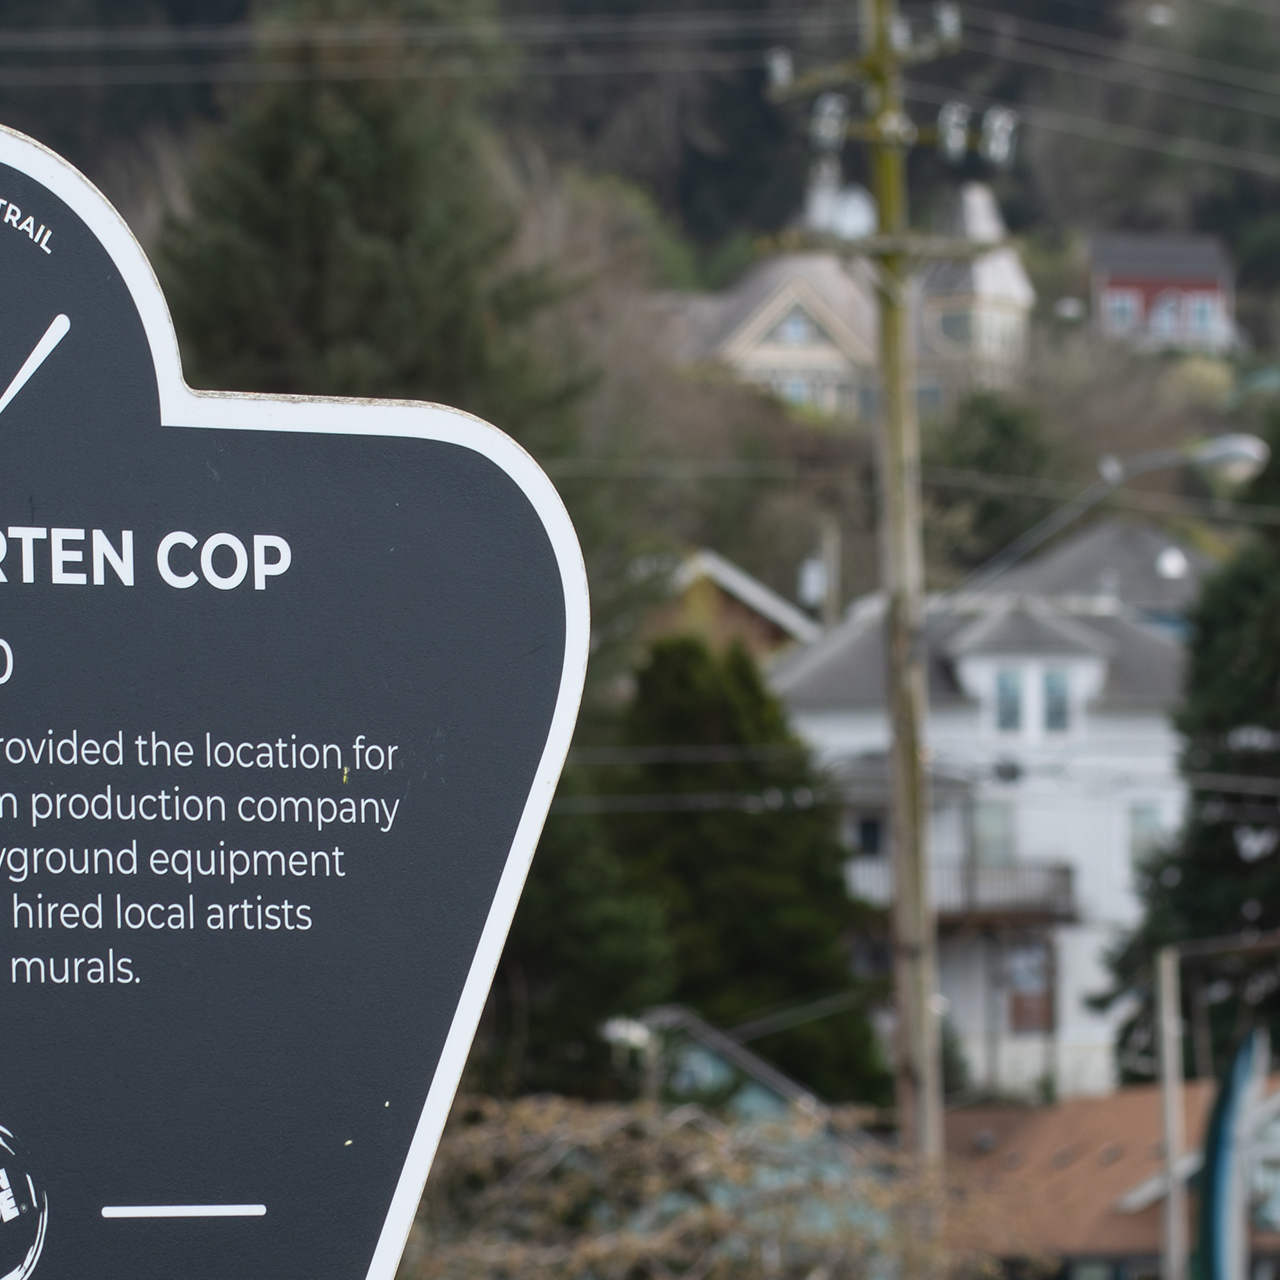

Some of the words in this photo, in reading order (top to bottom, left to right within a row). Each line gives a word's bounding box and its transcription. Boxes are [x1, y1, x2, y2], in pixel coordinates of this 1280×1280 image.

[157, 531, 291, 590] COP
[135, 731, 193, 766] the
[206, 732, 341, 769] location
[353, 735, 398, 770] for
[32, 785, 225, 827] production
[238, 797, 399, 832] company
[150, 841, 345, 884] equipment
[14, 893, 102, 928] hired
[117, 894, 193, 929] local
[207, 895, 312, 930] artists
[12, 948, 140, 983] murals.
